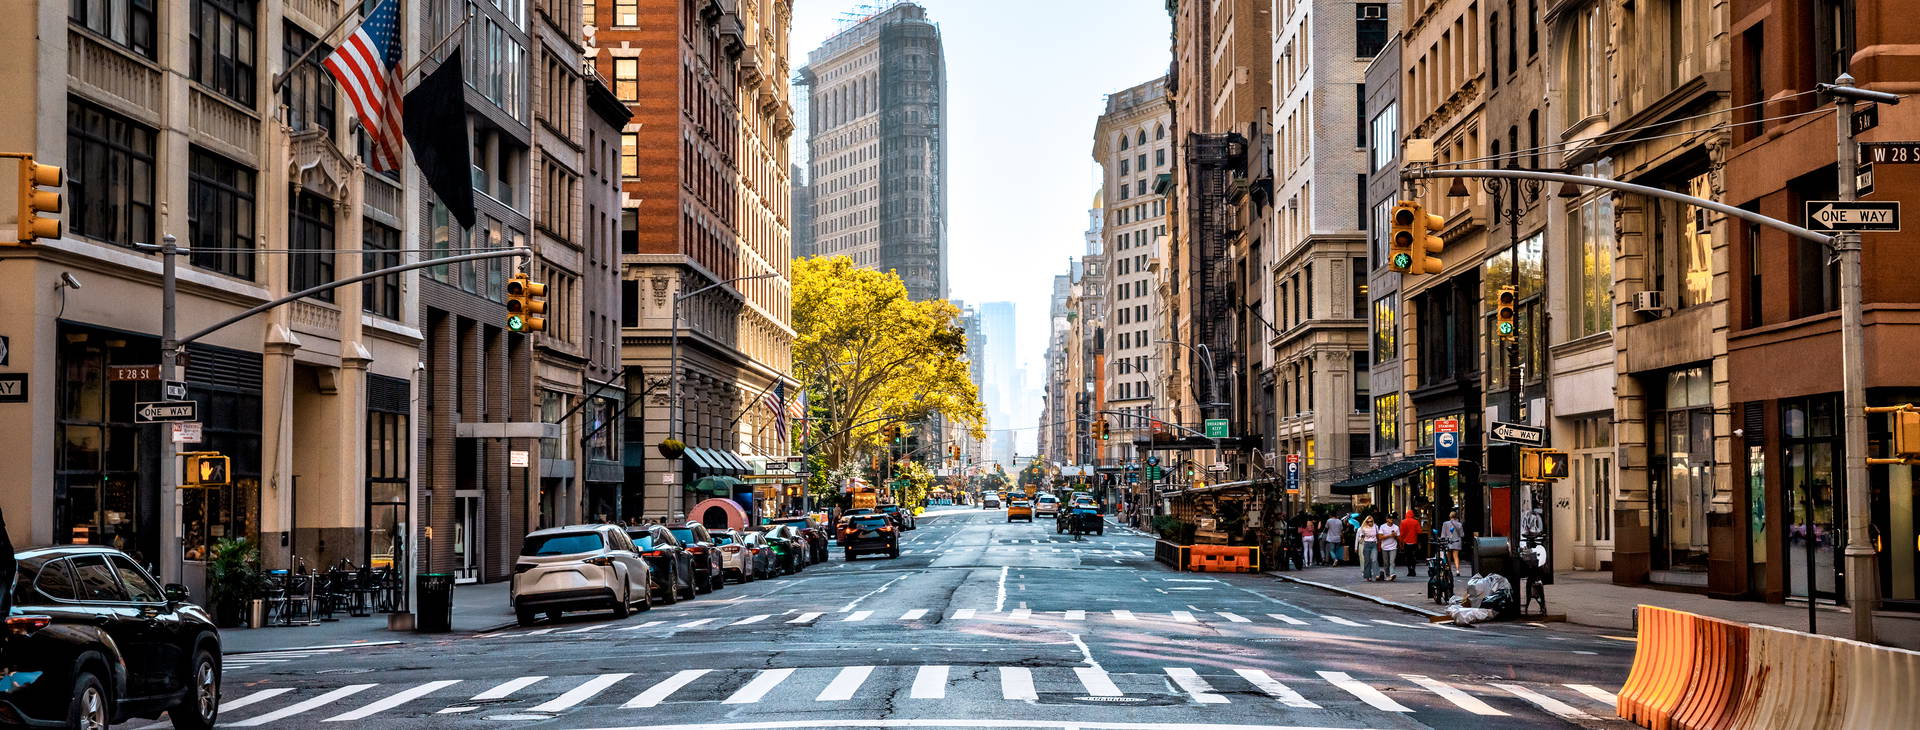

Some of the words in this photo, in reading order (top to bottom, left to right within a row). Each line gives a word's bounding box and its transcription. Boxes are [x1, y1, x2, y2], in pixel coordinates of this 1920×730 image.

[1859, 116, 1863, 131] 5
[1863, 114, 1871, 129] Av
[1874, 148, 1886, 162] W
[1891, 147, 1908, 162] 28
[1821, 210, 1848, 222] ONE
[1859, 210, 1887, 222] WAY
[119, 369, 124, 379] E
[126, 369, 138, 379] 28
[140, 368, 150, 379] St
[144, 408, 162, 417] ONE
[170, 407, 188, 416] WAY
[1498, 428, 1514, 437] ONE
[1520, 431, 1537, 440] WAY
